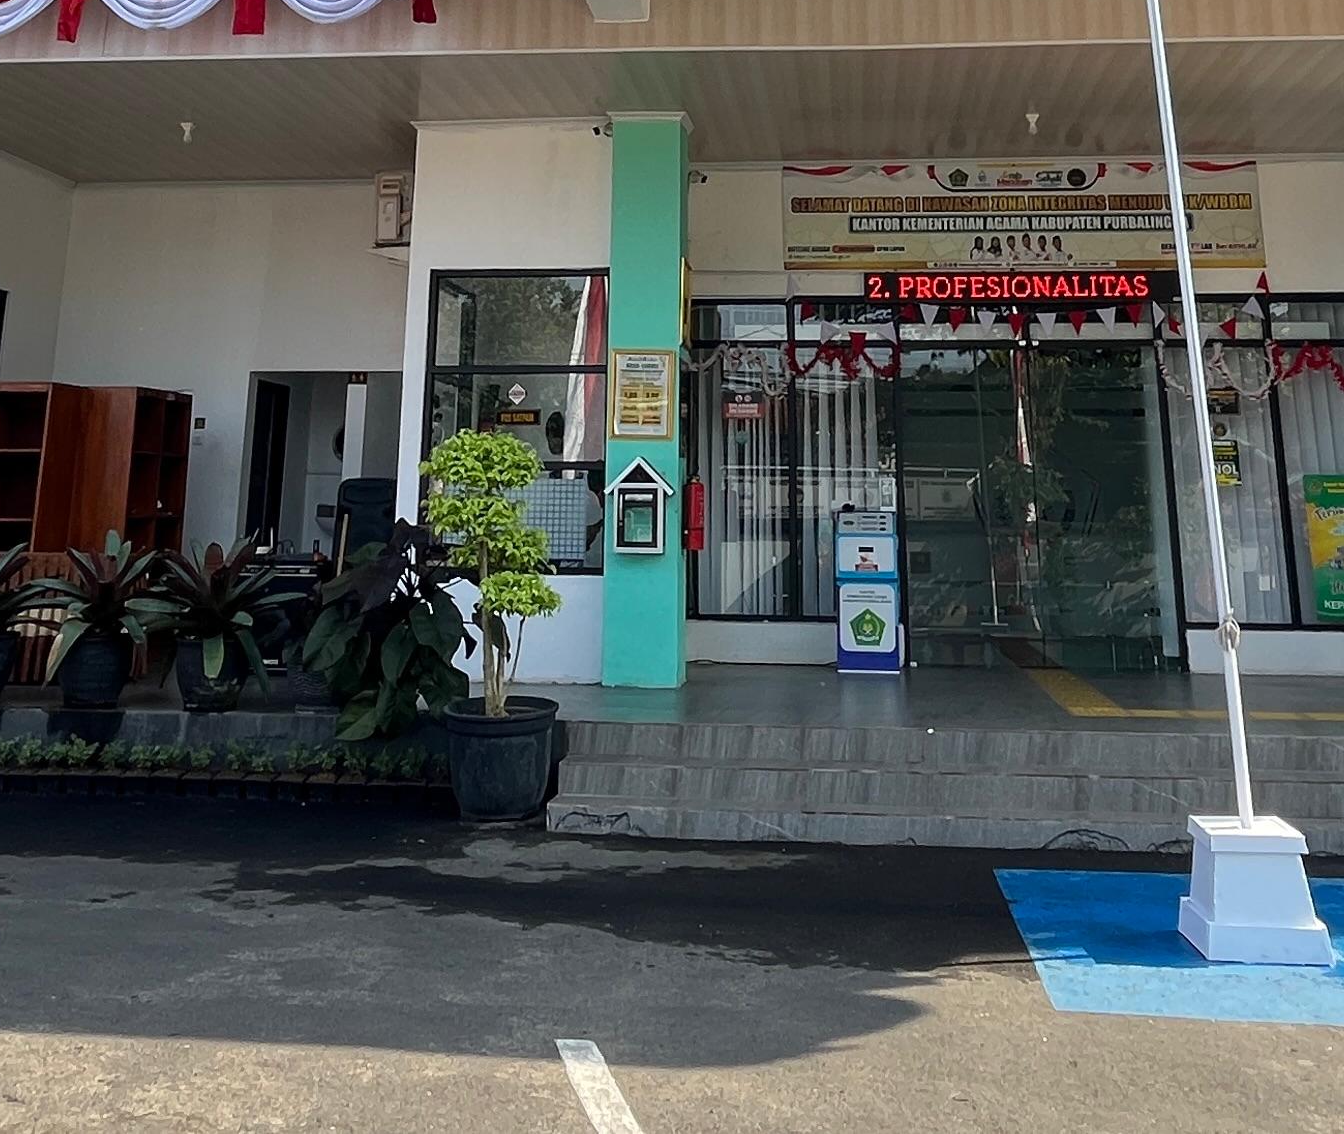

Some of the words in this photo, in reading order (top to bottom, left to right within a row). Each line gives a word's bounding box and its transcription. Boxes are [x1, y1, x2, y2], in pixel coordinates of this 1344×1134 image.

[791, 197, 850, 213] SELAMAT
[851, 197, 904, 212] DATANG
[905, 197, 921, 212] DI
[922, 196, 990, 212] KAWASAN
[990, 196, 1026, 212] ZONA
[1028, 195, 1106, 211] INTEGRITAS
[1107, 195, 1163, 211] MENUJU
[852, 217, 900, 231] KANTOR
[902, 216, 984, 231] KEMENTERIAN
[985, 216, 1030, 230] AGAMA
[1031, 216, 1102, 230] KABUPATEN
[868, 277, 890, 298] 2.
[898, 275, 1149, 298] PROFESIONALITAS
